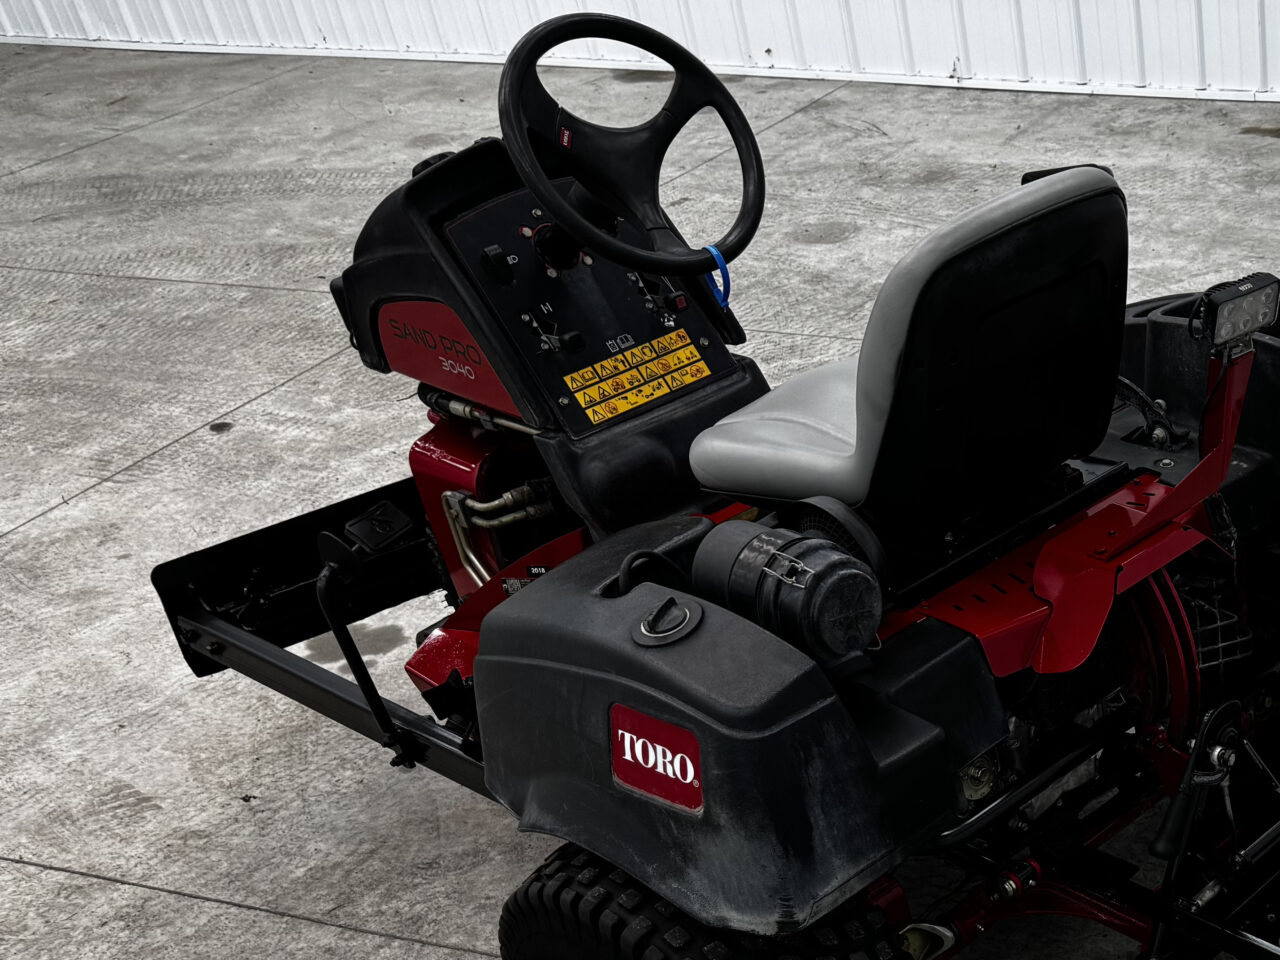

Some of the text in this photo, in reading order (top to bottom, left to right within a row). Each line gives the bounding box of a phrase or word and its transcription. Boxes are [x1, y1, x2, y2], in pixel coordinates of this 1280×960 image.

[389, 318, 482, 365] SAND PRO
[439, 356, 475, 380] 3040
